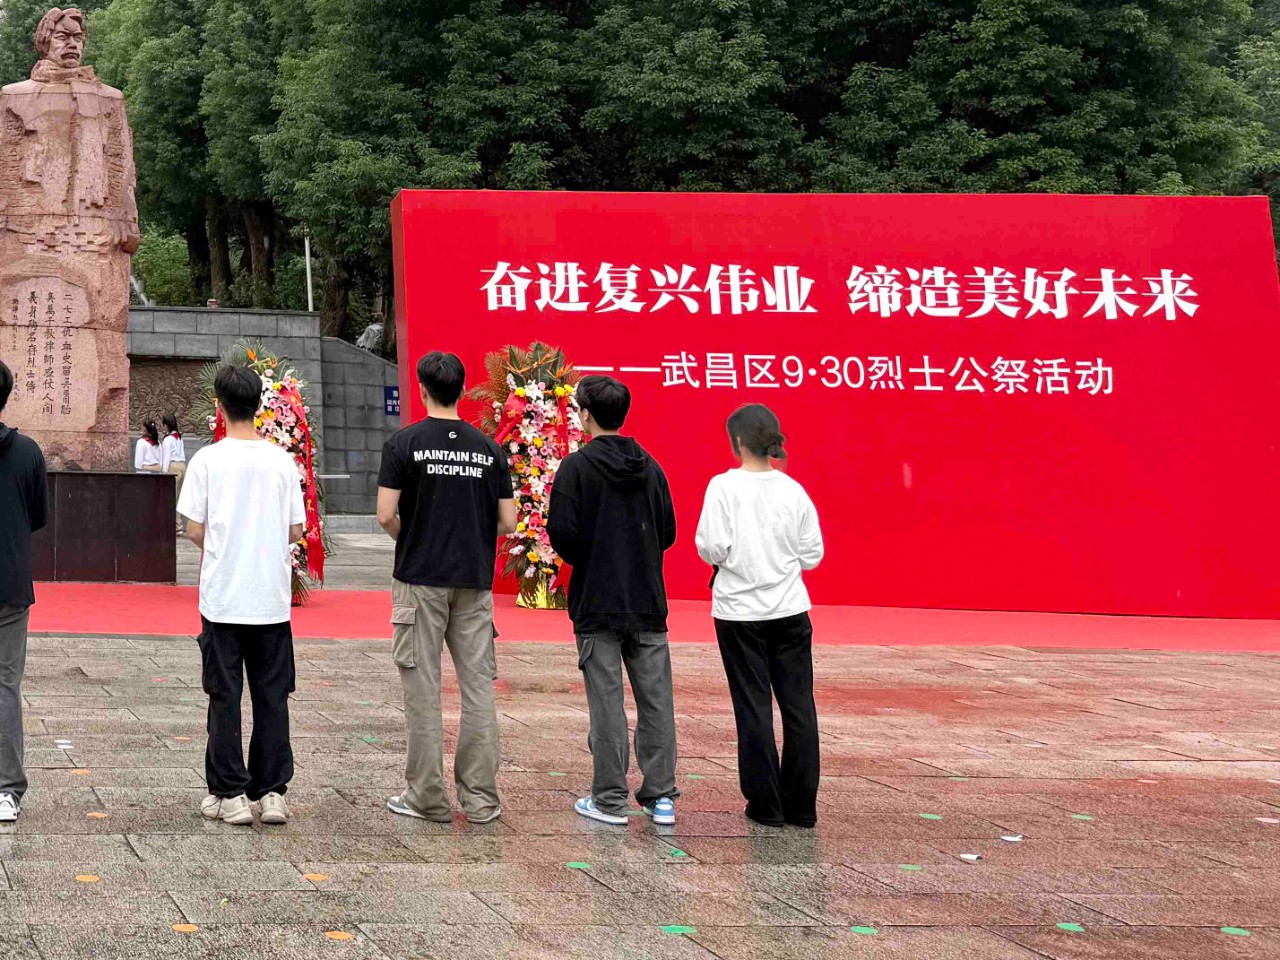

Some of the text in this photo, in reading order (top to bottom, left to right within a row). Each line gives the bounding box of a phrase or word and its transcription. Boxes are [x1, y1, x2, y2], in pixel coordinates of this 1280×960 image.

[480, 262, 1200, 321] 奋进复兴伟业 缔造美好未来
[413, 449, 494, 466] MAINTAIN SELF
[427, 464, 483, 478] DISCIPLINE
